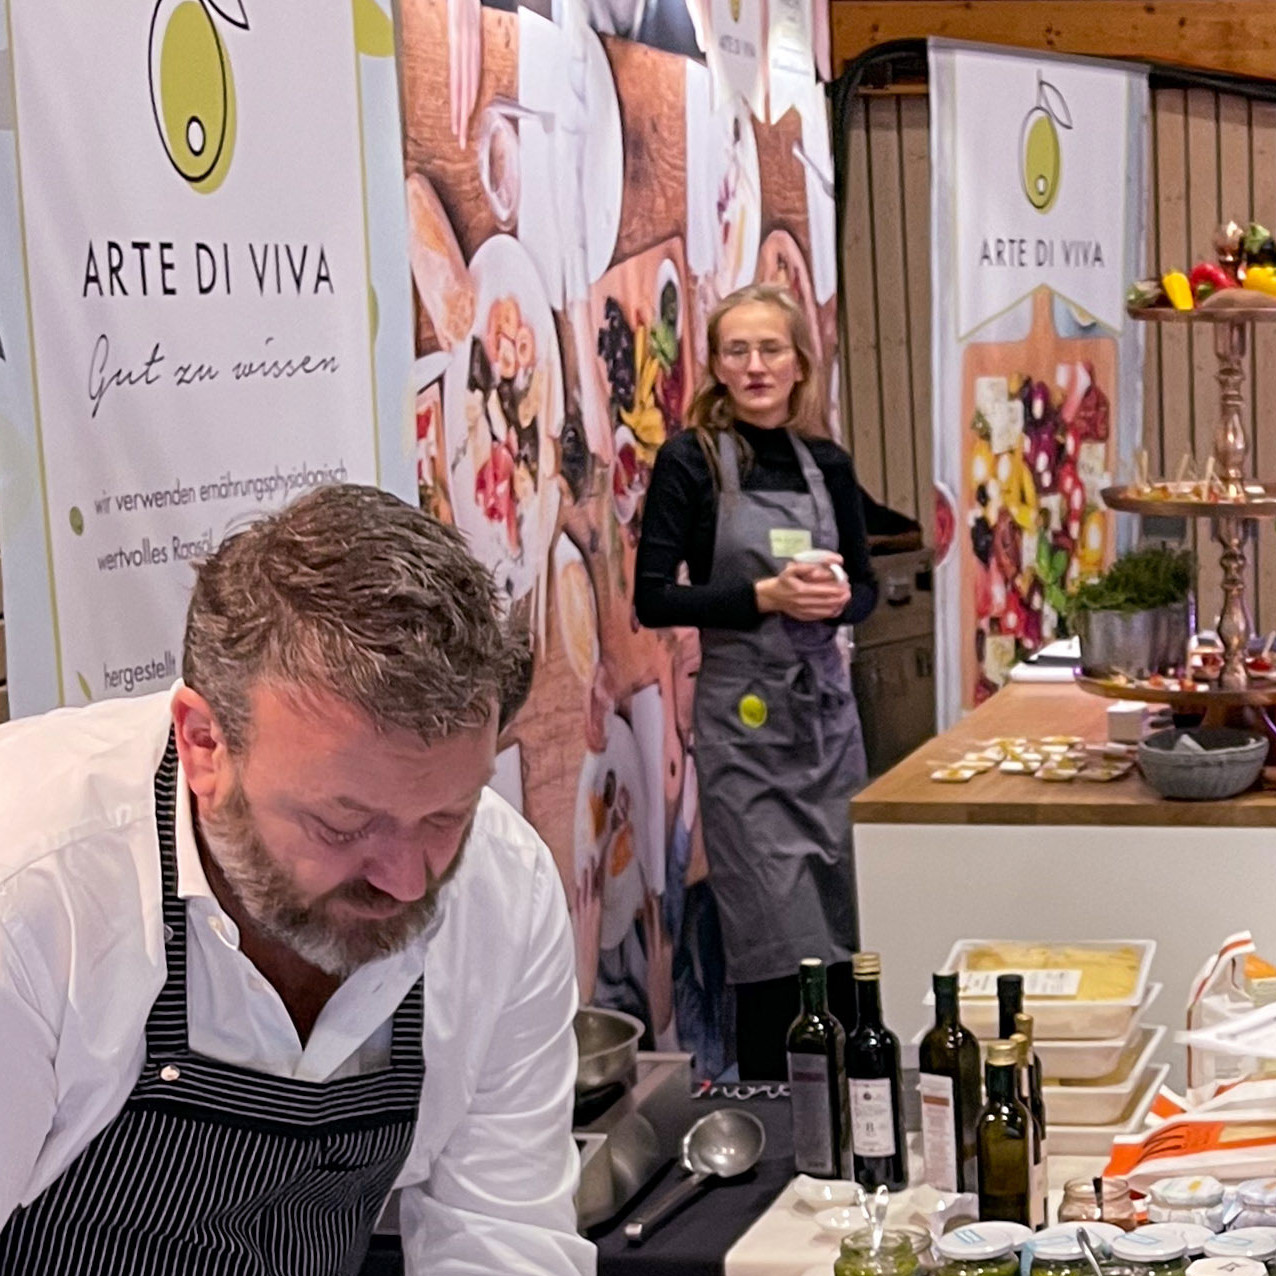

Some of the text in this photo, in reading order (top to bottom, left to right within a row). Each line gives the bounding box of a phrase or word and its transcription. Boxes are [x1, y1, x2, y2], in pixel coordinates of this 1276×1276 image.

[82, 239, 335, 298] ARTE DI VIVA
[979, 238, 1106, 268] ARTE DI VIVA
[88, 333, 340, 419] Gut zu wissen
[94, 488, 111, 514] wir
[115, 477, 196, 511] verwenden
[97, 538, 168, 571] wertvolles
[102, 650, 177, 692] hergestellt
